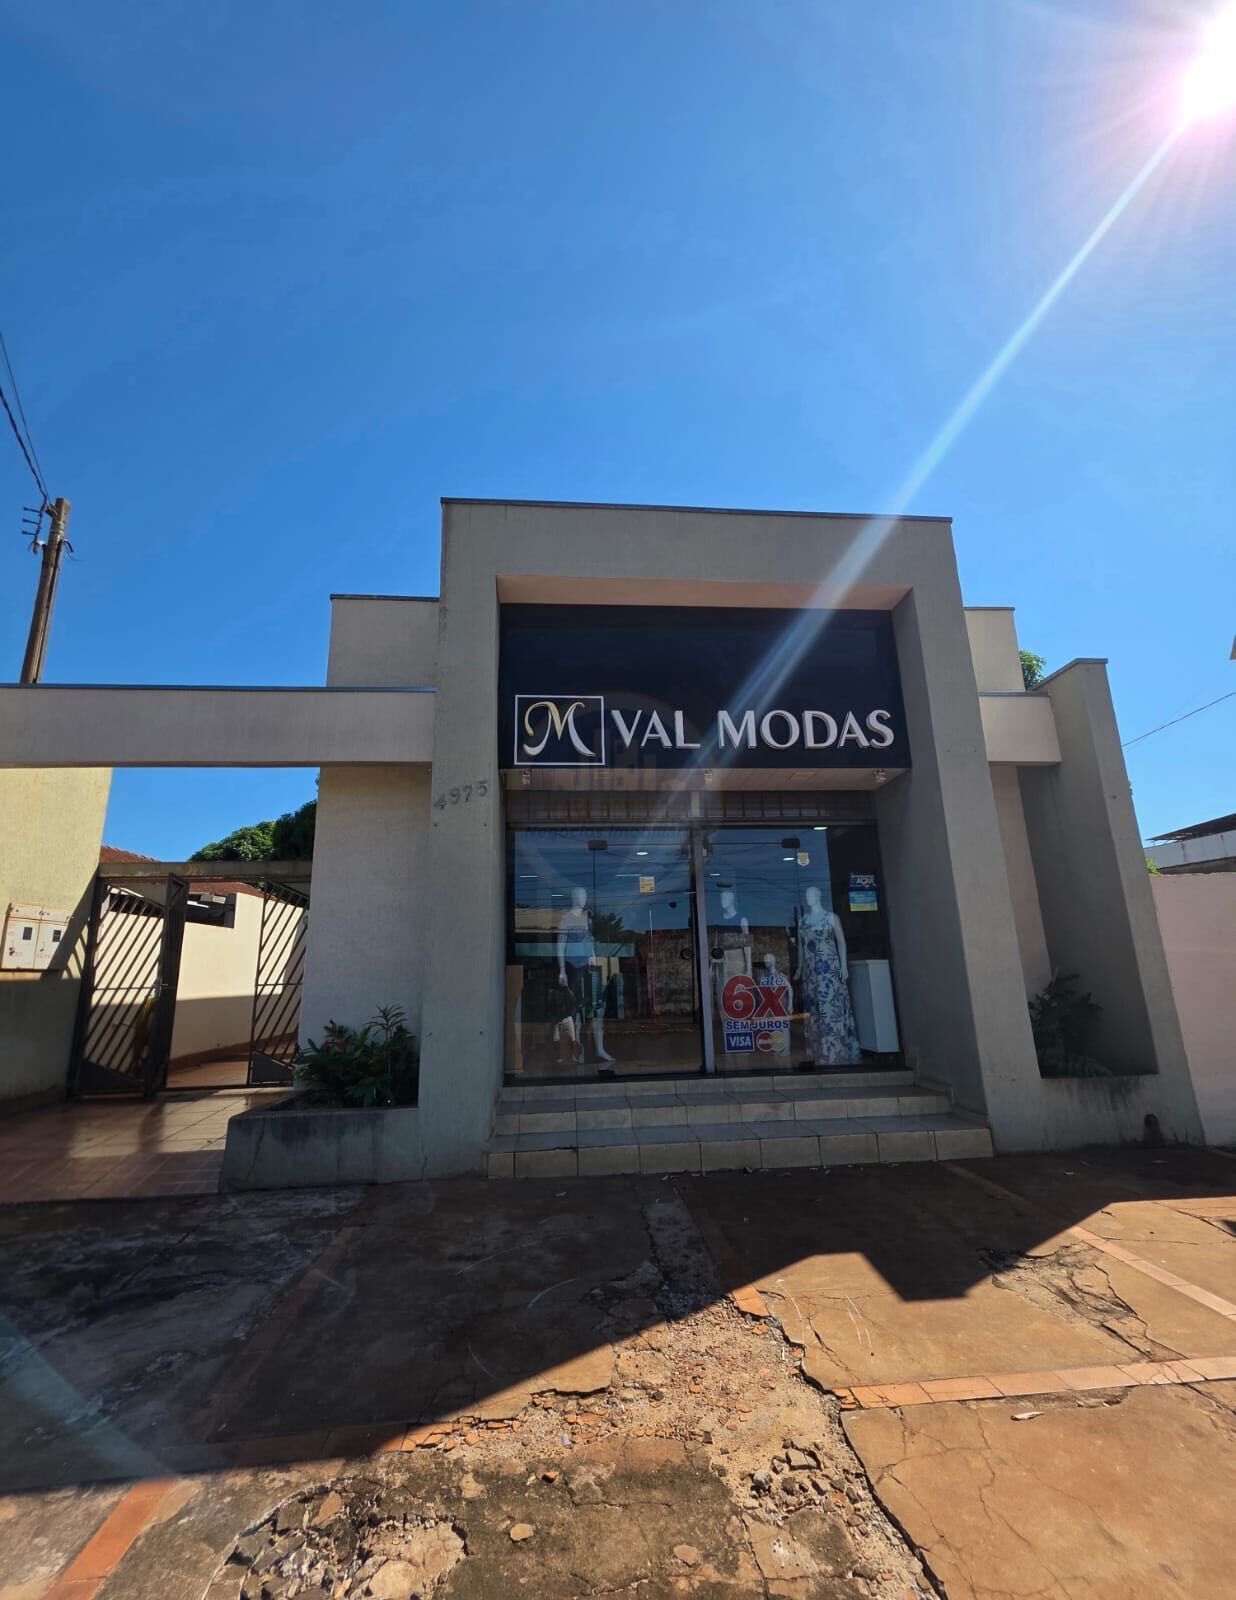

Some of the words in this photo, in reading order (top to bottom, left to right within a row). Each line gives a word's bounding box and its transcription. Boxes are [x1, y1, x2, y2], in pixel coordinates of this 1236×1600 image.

[610, 709, 701, 750] VAL
[717, 709, 895, 750] MODAS
[432, 780, 488, 810] 4975
[726, 1020, 749, 1030] SEM
[751, 1019, 789, 1030] JUROS
[729, 1036, 752, 1047] VISA
